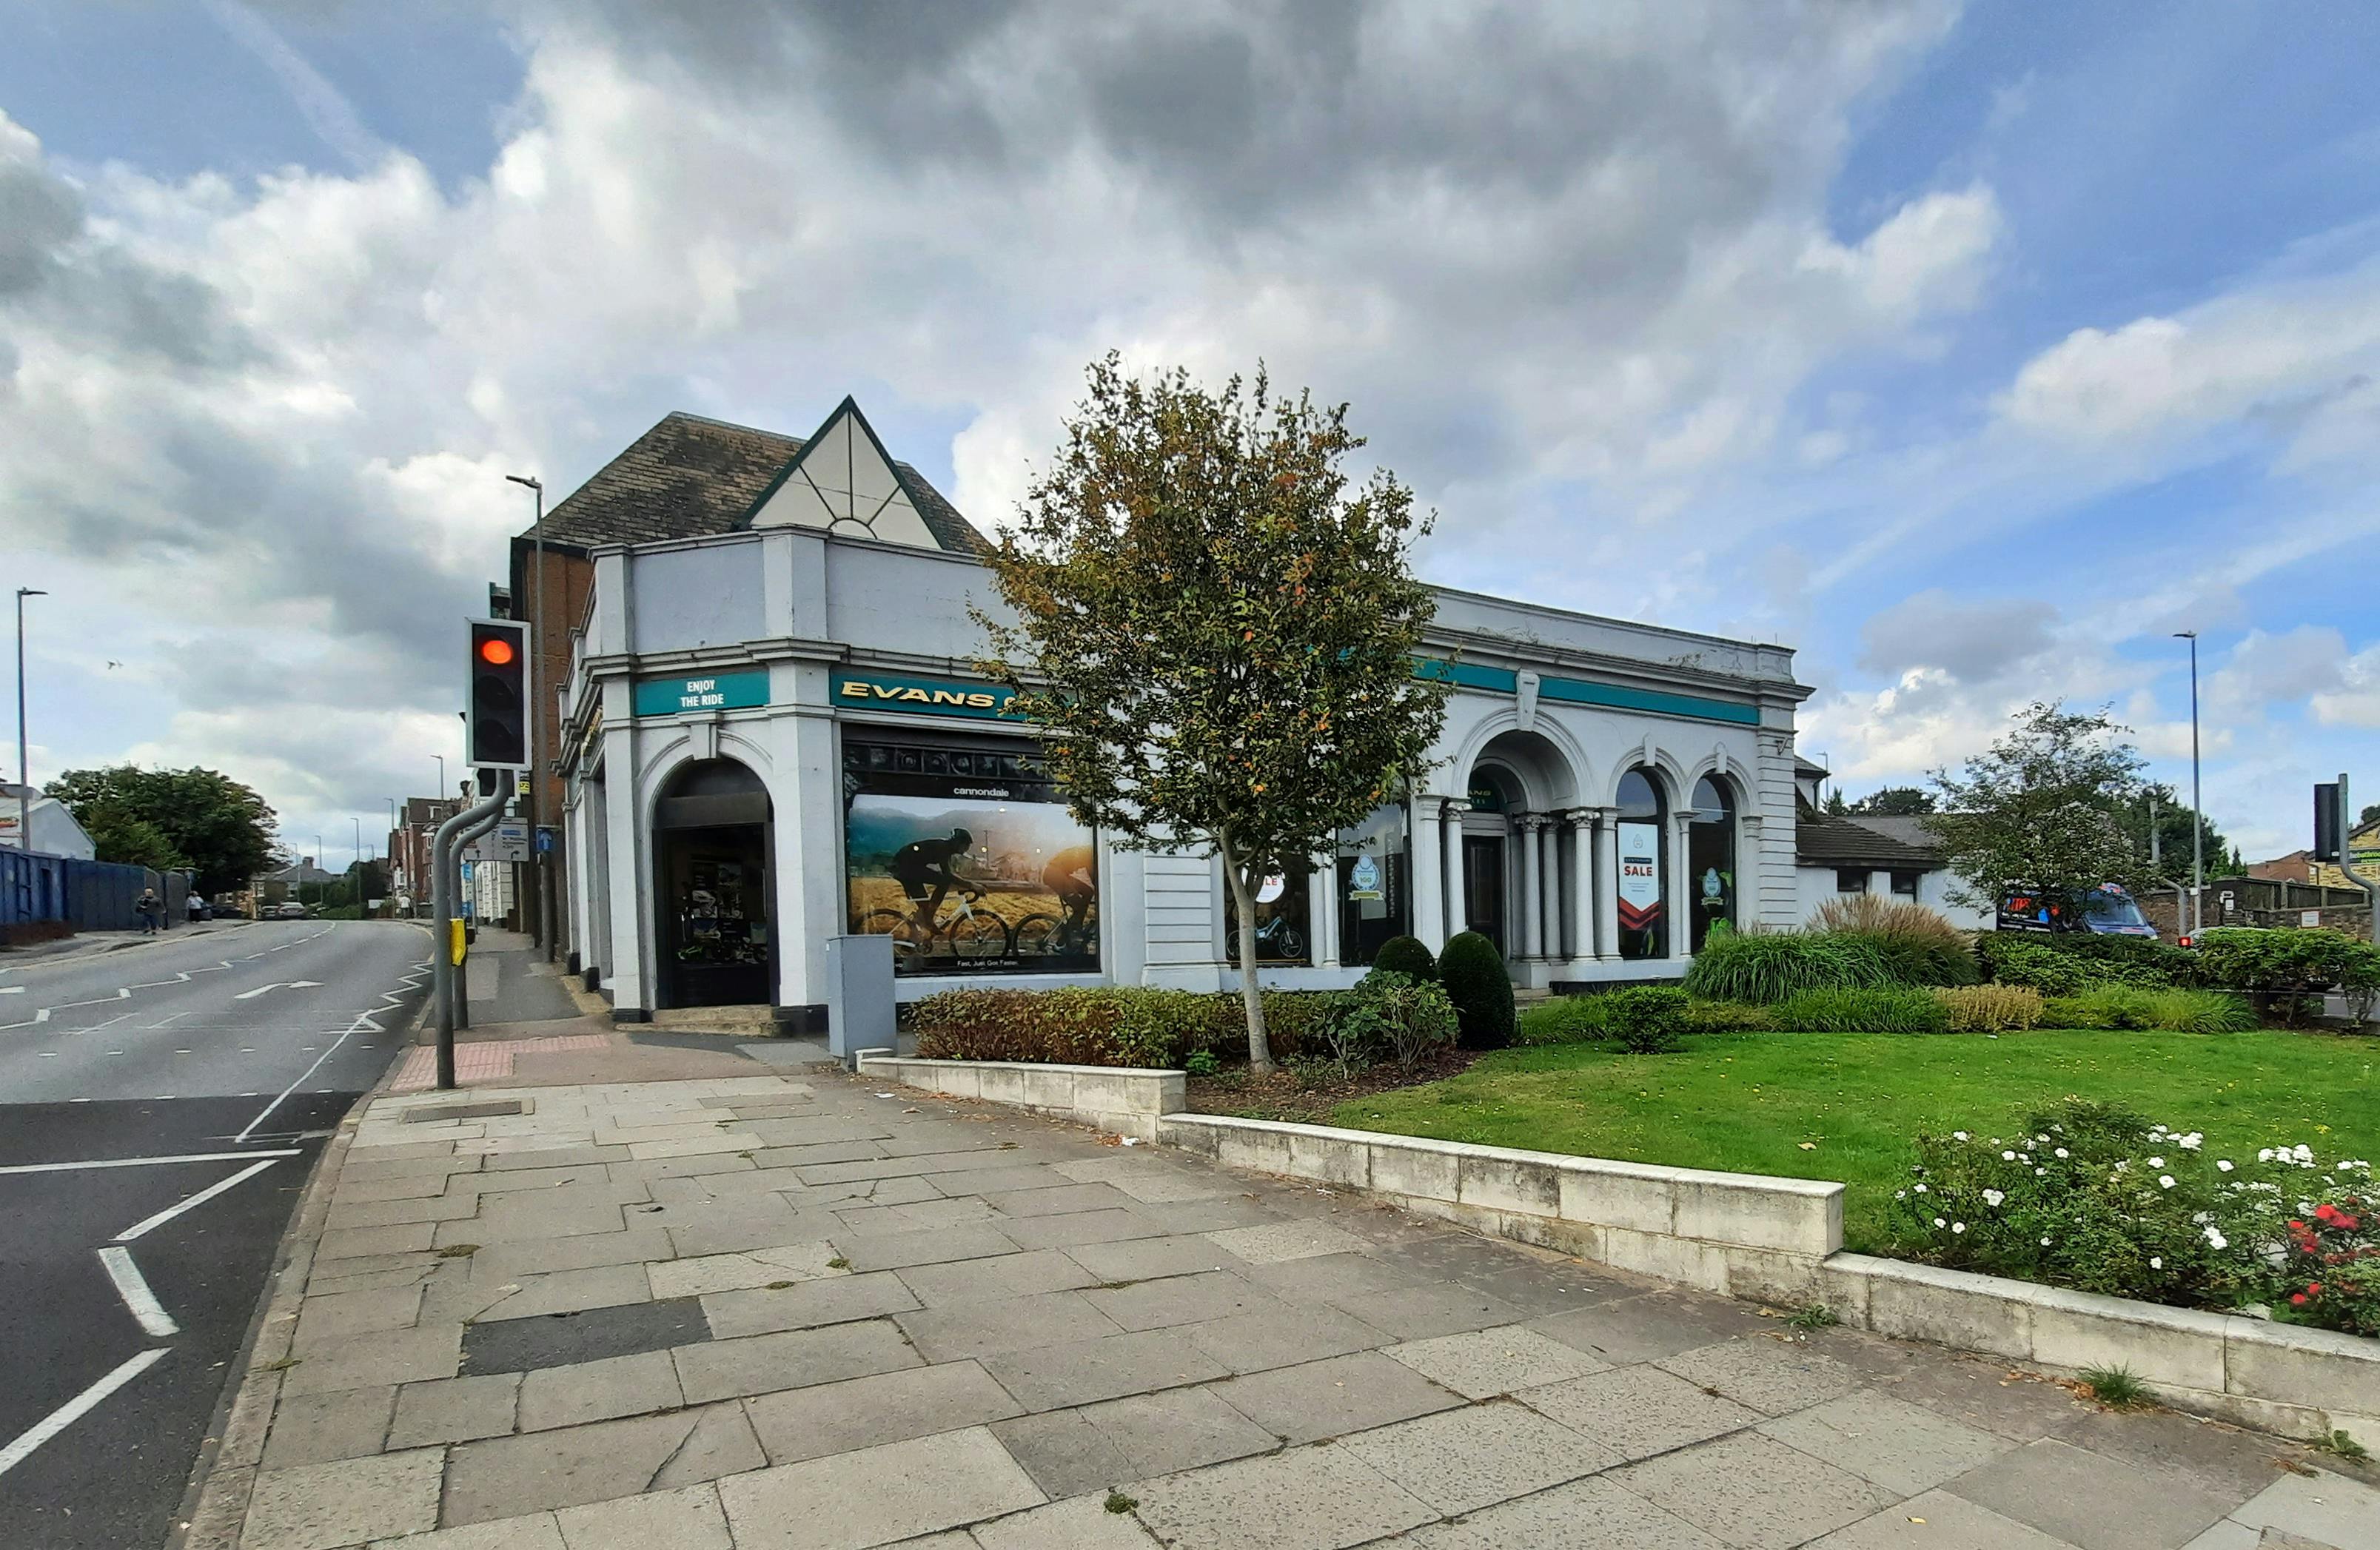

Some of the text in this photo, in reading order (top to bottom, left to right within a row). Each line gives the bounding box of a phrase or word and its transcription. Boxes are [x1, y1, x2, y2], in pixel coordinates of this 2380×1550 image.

[687, 680, 715, 694] ENJOY
[842, 681, 996, 708] EVANS
[680, 694, 724, 708] THE RIDE
[953, 788, 1010, 797] cannondale
[1624, 865, 1653, 876] SALE
[1265, 877, 1278, 886] LE
